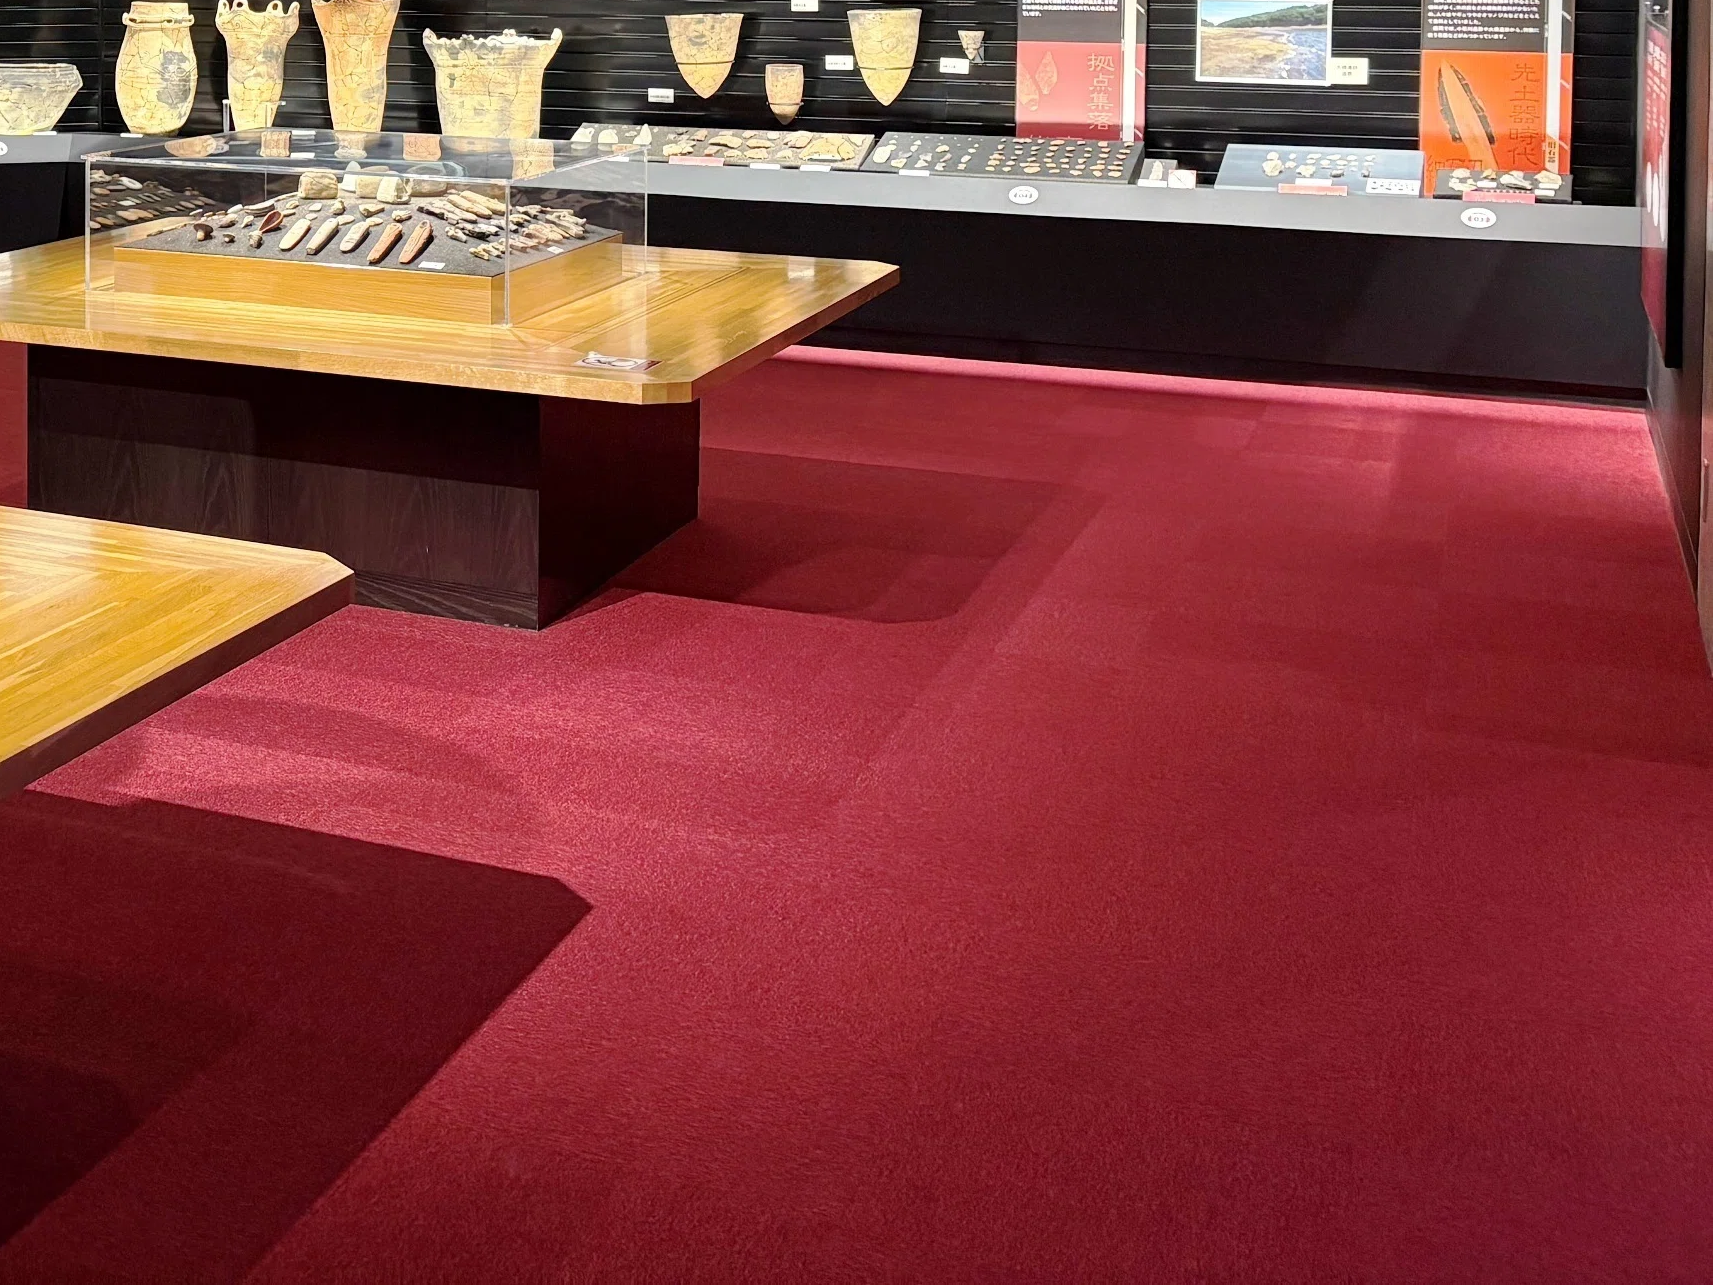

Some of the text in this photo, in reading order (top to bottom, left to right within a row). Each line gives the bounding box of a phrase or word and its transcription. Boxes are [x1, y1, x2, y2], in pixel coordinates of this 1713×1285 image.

[1087, 52, 1115, 130] 拠点集落
[1507, 63, 1540, 166] 先土器時代
